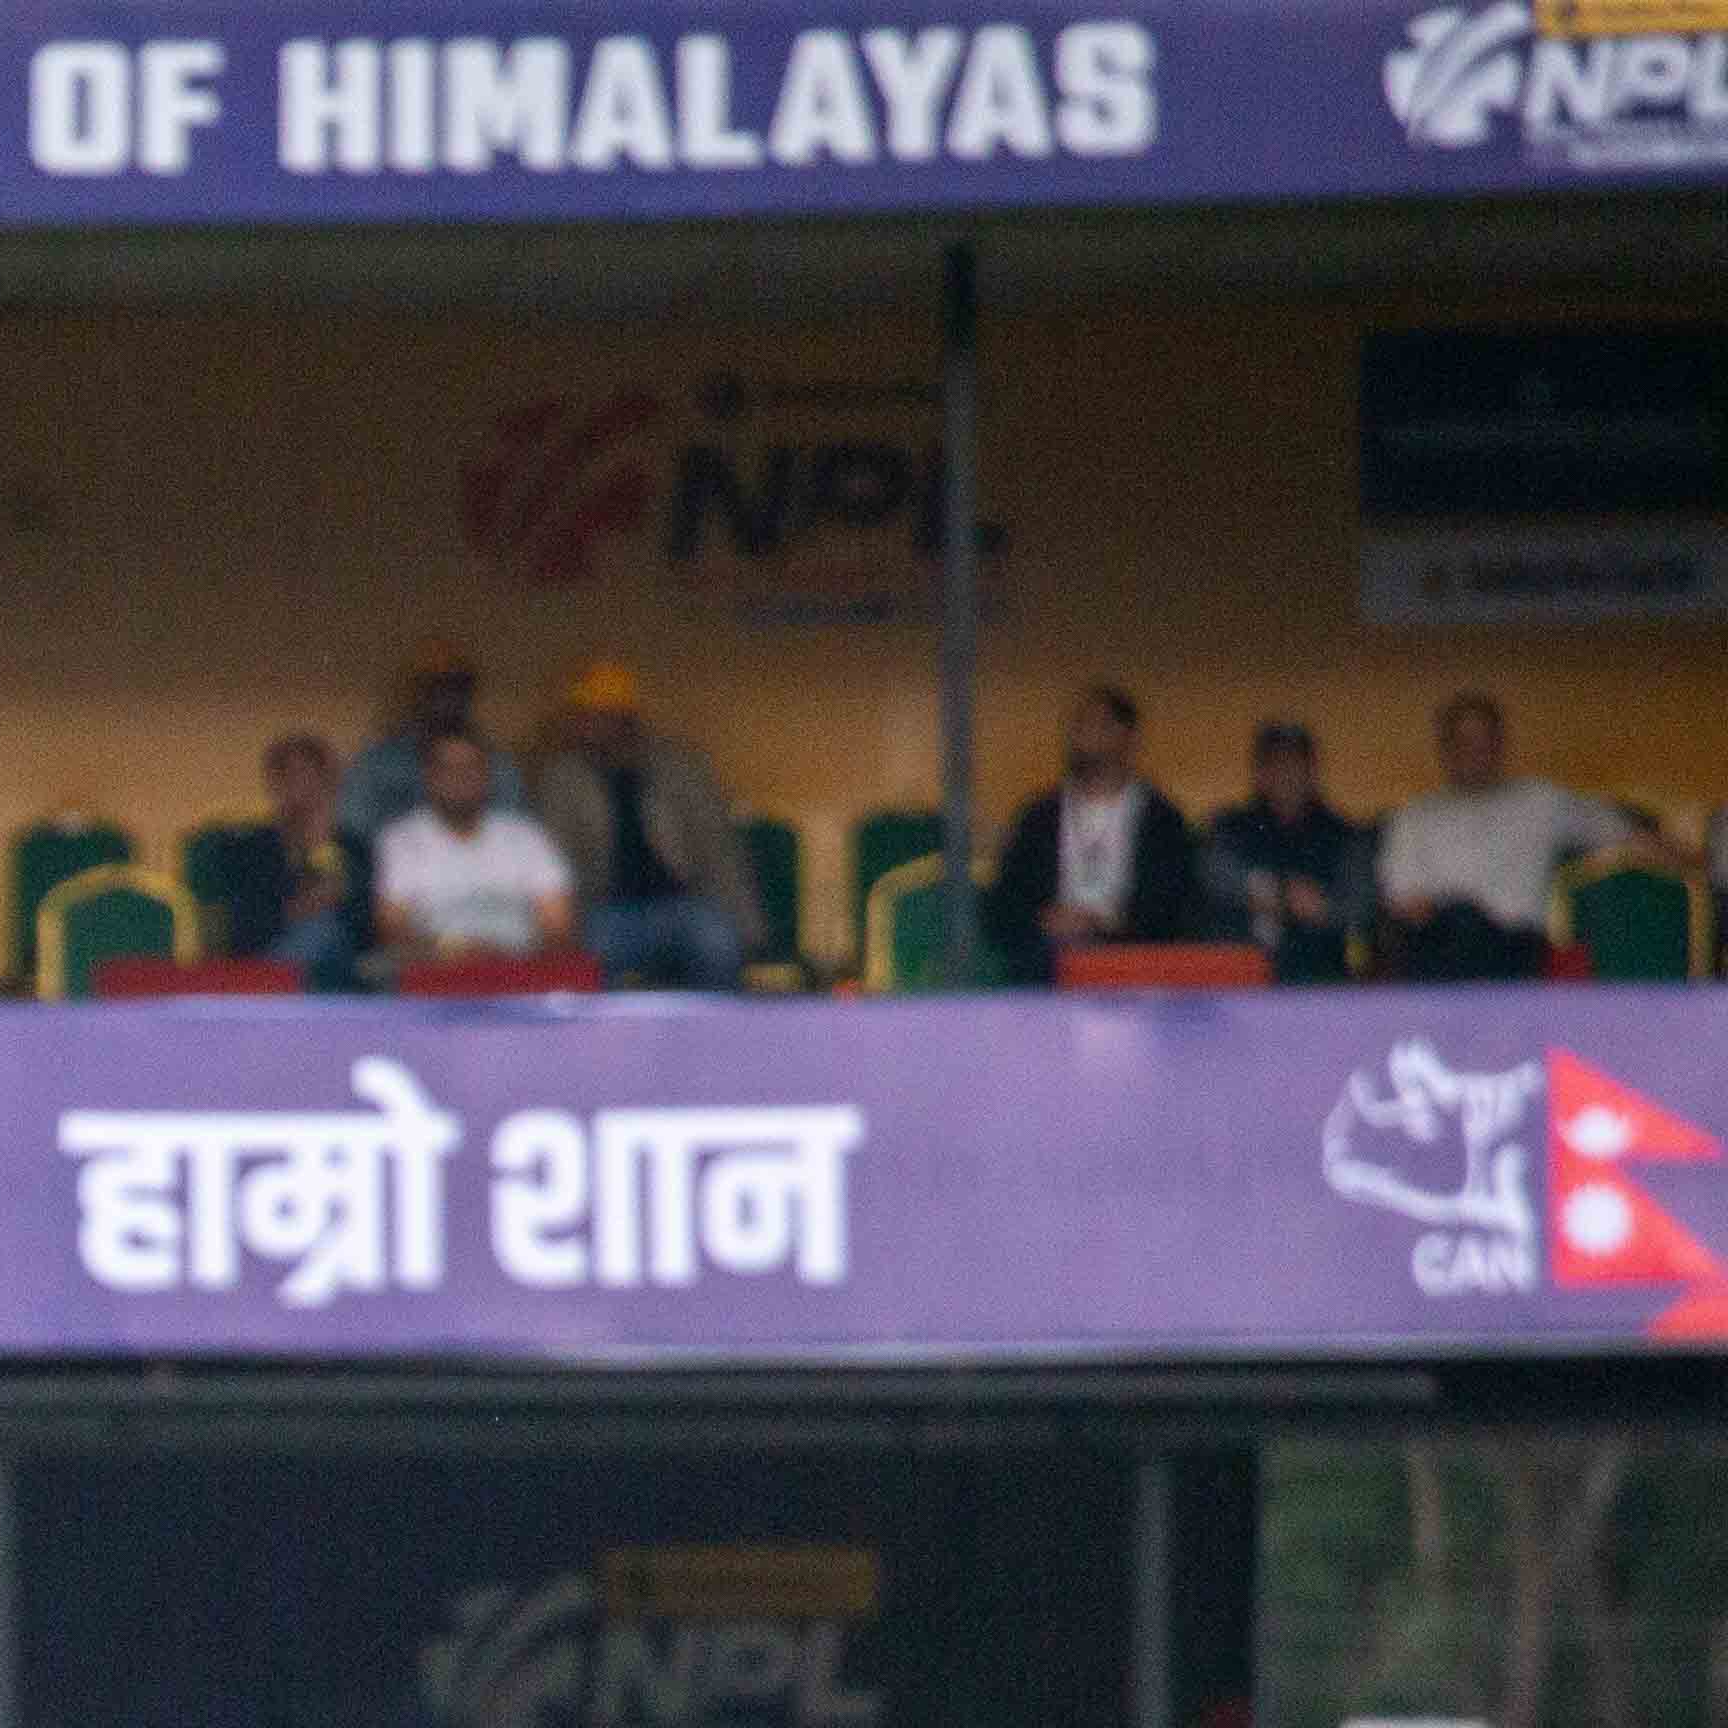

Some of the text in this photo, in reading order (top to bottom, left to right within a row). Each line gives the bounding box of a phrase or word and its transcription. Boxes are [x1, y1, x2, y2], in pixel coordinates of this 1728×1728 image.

[31, 42, 222, 174] OF
[278, 23, 1155, 172] HIMALAYAS
[57, 1057, 864, 1306] हाम्रो शान
[1412, 1233, 1537, 1295] CAN
